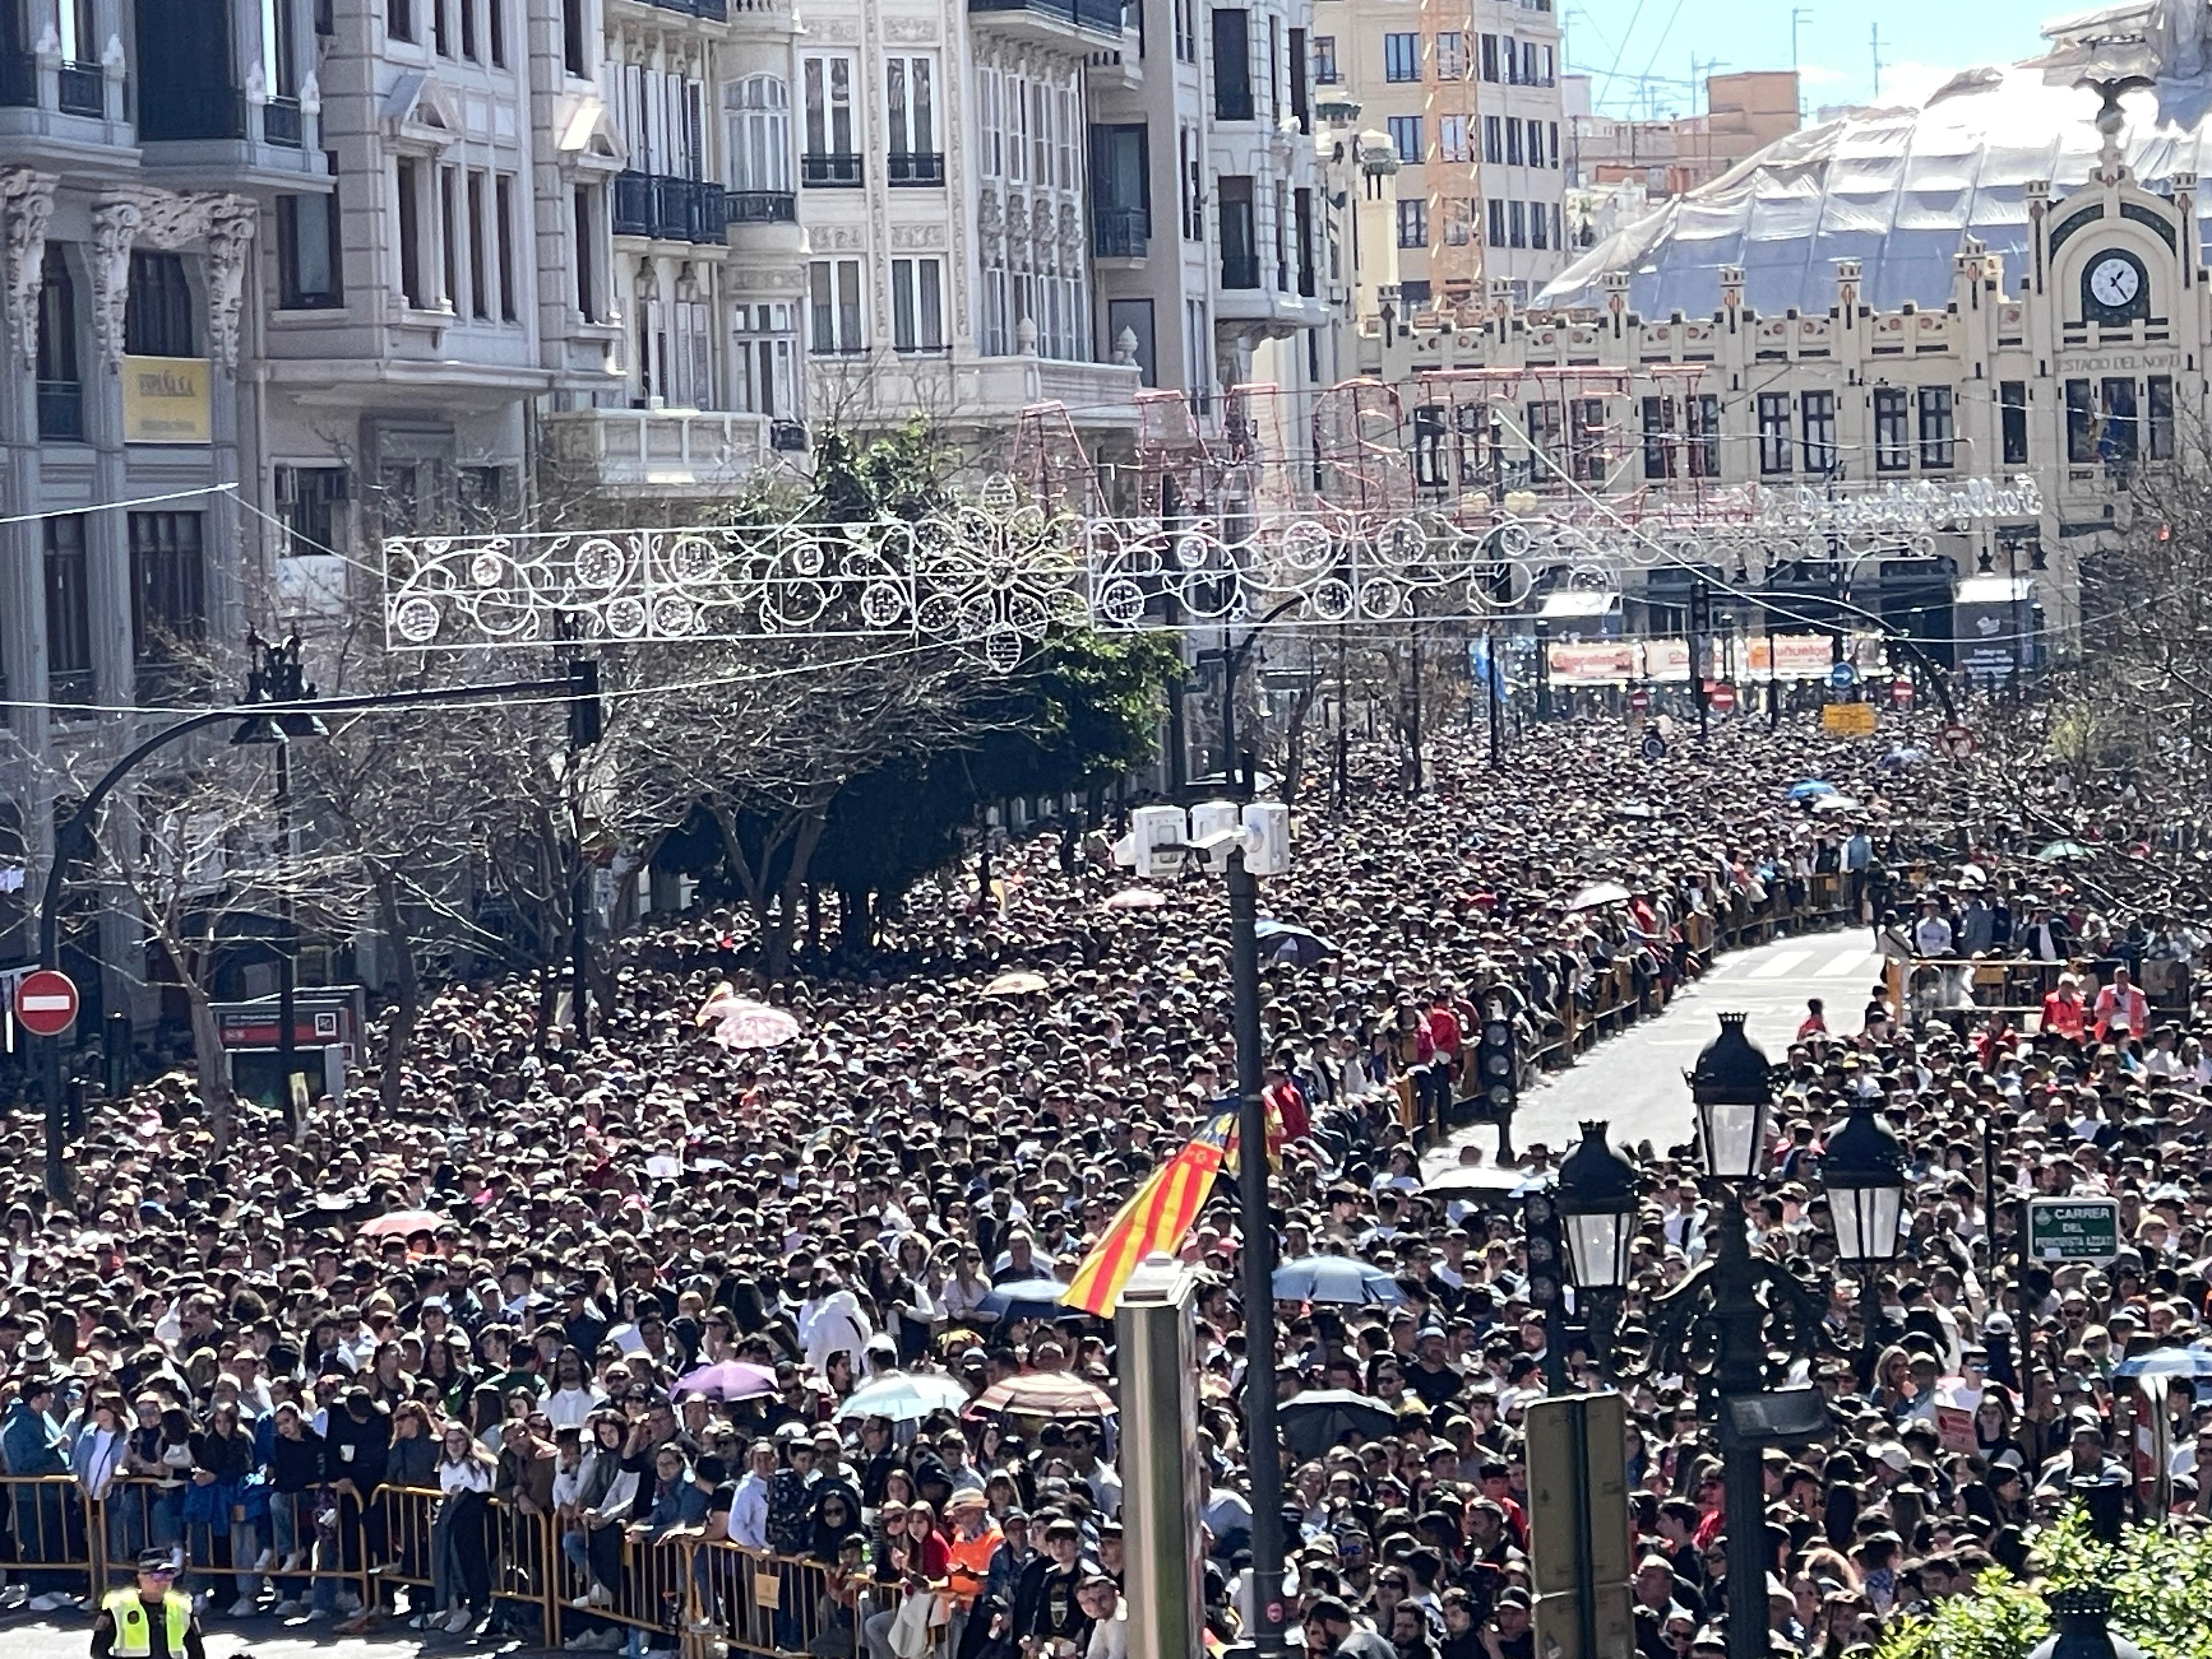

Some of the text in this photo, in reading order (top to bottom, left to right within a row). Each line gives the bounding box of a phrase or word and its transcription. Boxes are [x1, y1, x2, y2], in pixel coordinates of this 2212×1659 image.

[2114, 356, 2141, 370] DEL
[2054, 1207, 2110, 1220] CARRER
[2062, 1223, 2085, 1233] DEL
